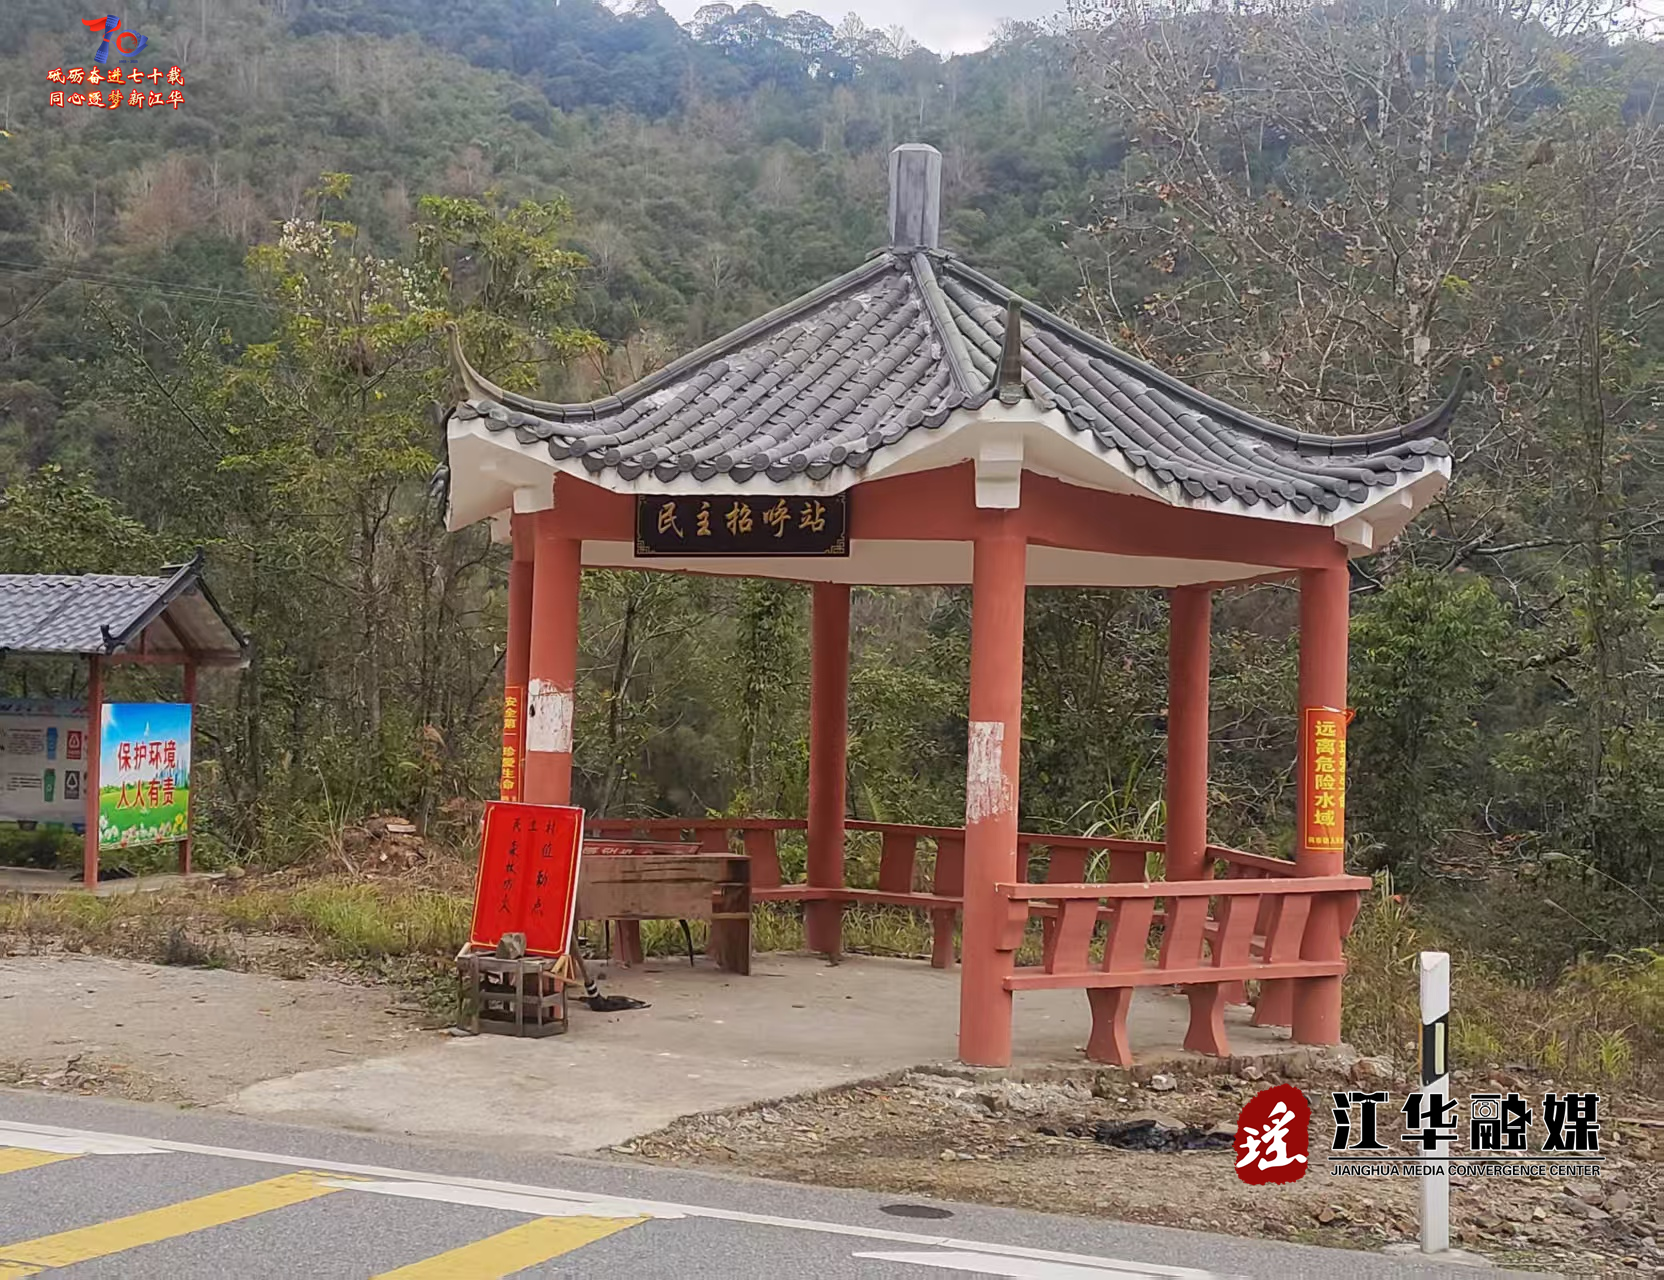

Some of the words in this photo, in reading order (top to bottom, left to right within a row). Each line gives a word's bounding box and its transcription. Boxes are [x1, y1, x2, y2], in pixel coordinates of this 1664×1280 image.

[657, 499, 827, 538] 民主招呼站
[504, 696, 517, 736] 安全第一
[117, 740, 177, 771] 保护环境
[1314, 720, 1336, 826] 远离危险水域
[117, 777, 175, 808] 人人有责
